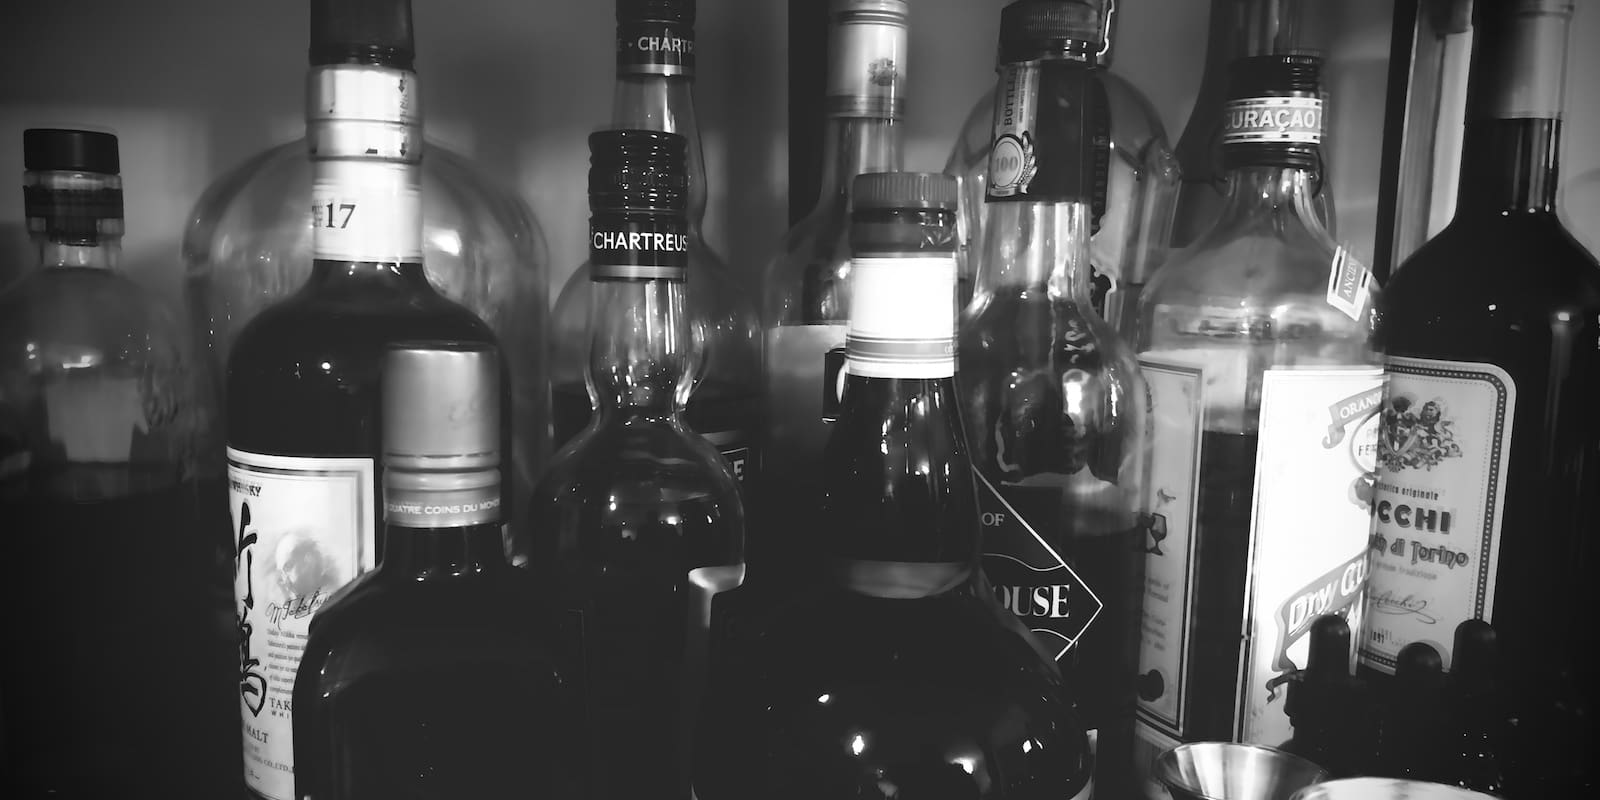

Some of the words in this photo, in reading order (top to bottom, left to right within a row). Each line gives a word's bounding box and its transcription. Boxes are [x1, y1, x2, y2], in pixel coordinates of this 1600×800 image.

[325, 202, 357, 230] 17
[424, 505, 461, 515] COINS
[463, 503, 478, 513] DU
[981, 512, 1005, 527] OF
[1410, 540, 1470, 570] Torino
